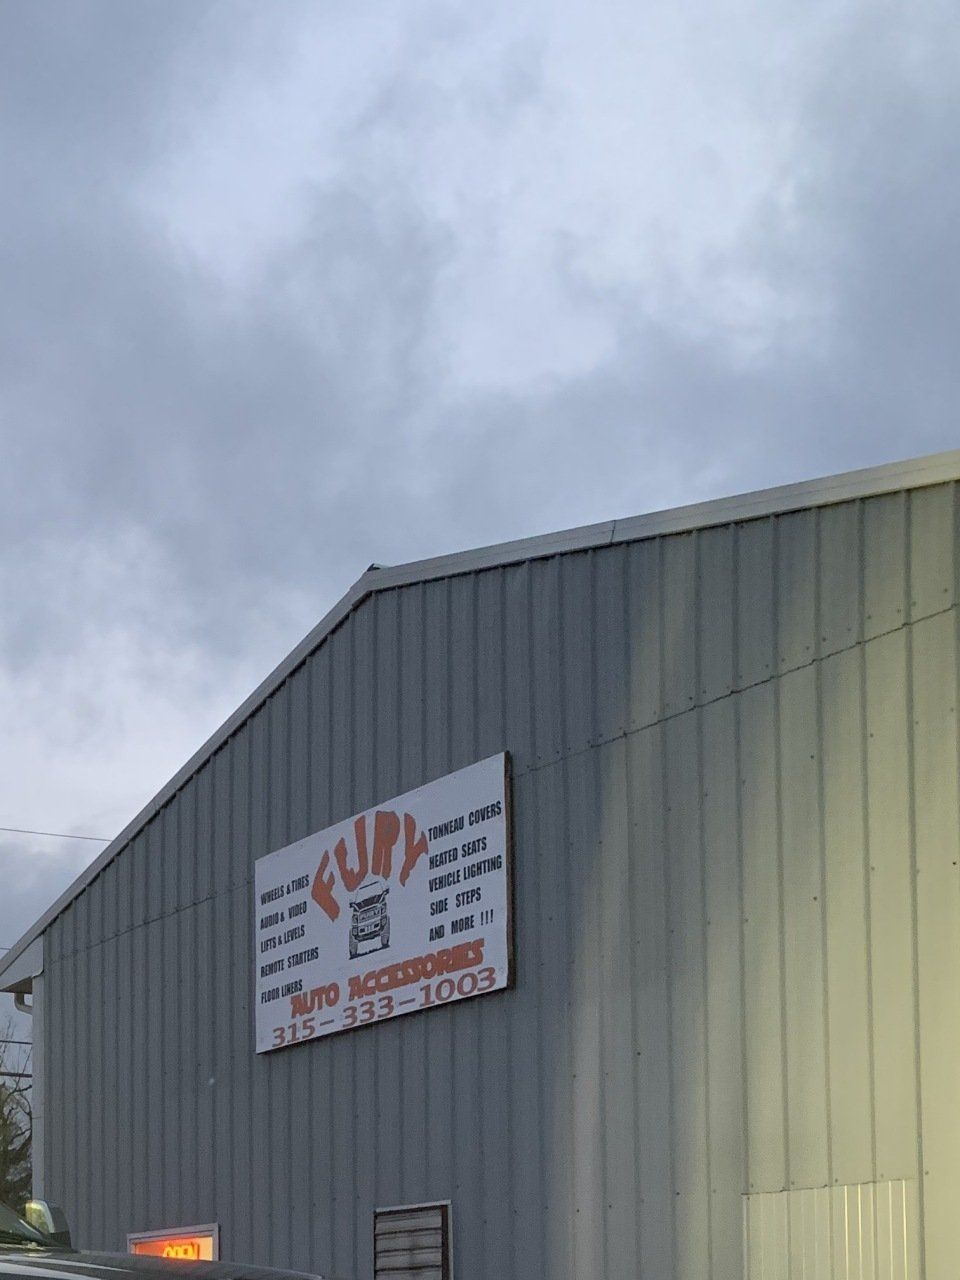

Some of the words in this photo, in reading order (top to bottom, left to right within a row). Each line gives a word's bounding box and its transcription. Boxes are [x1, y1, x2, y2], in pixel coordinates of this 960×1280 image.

[428, 816, 465, 842] TONNEAU
[468, 801, 502, 827] COVERS
[311, 810, 429, 922] FURY
[429, 848, 458, 870] HEATED
[461, 837, 487, 859] SEATS
[429, 869, 461, 893] VEHICLE
[463, 855, 502, 881] LIGHTING
[260, 885, 284, 906] WHEELS
[291, 875, 309, 892] TIRES
[430, 898, 448, 916] SIDE
[455, 887, 482, 909] STEPS
[260, 912, 279, 931] AUDIO
[288, 901, 307, 920] VIDEO
[429, 924, 445, 942] AND
[451, 915, 474, 935] MORE
[260, 937, 276, 954] LIFTS
[284, 925, 305, 944] LEVELS
[260, 959, 284, 978] REMOTE
[287, 947, 319, 969] STARTERS
[261, 986, 280, 1004] FLOOR
[281, 979, 303, 998] LINERS
[290, 982, 340, 1019] AUTO
[348, 938, 485, 1000] ACCESSORIES
